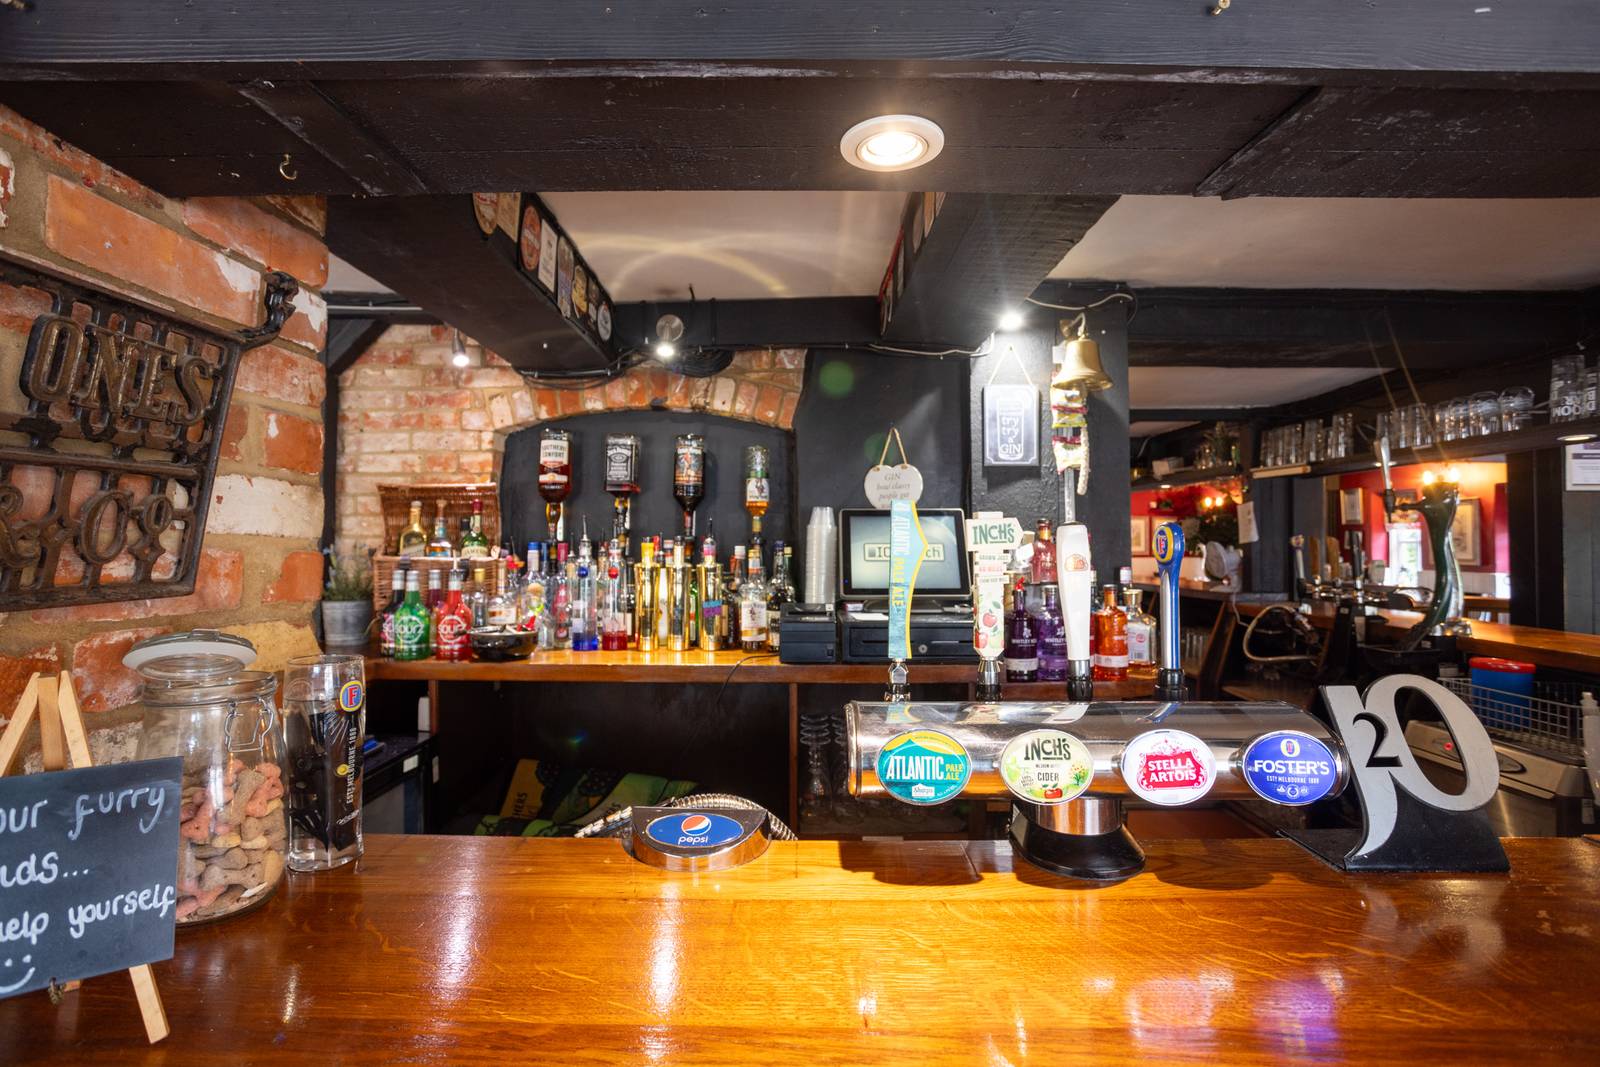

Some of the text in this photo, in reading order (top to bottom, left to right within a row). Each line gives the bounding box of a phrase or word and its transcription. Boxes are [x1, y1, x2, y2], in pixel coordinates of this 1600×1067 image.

[1002, 416, 1019, 427] try
[1002, 427, 1019, 438] try
[1000, 443, 1021, 454] GIN
[884, 473, 901, 481] GIN
[892, 557, 905, 583] PALE
[891, 585, 905, 608] ALE
[348, 686, 358, 707] F
[1024, 738, 1071, 760] INCH'S
[886, 755, 944, 780] ATLANTIC
[945, 763, 963, 772] PALE
[1148, 757, 1195, 771] STELLA
[1254, 760, 1330, 775] FOSTER'S
[945, 772, 960, 780] ALE
[1037, 772, 1060, 781] CIDER
[1150, 770, 1197, 782] ARTOIS
[1278, 776, 1307, 784] MELBOURNE
[68, 787, 165, 841] furry
[678, 835, 709, 845] pepsi
[68, 884, 175, 939] yourself
